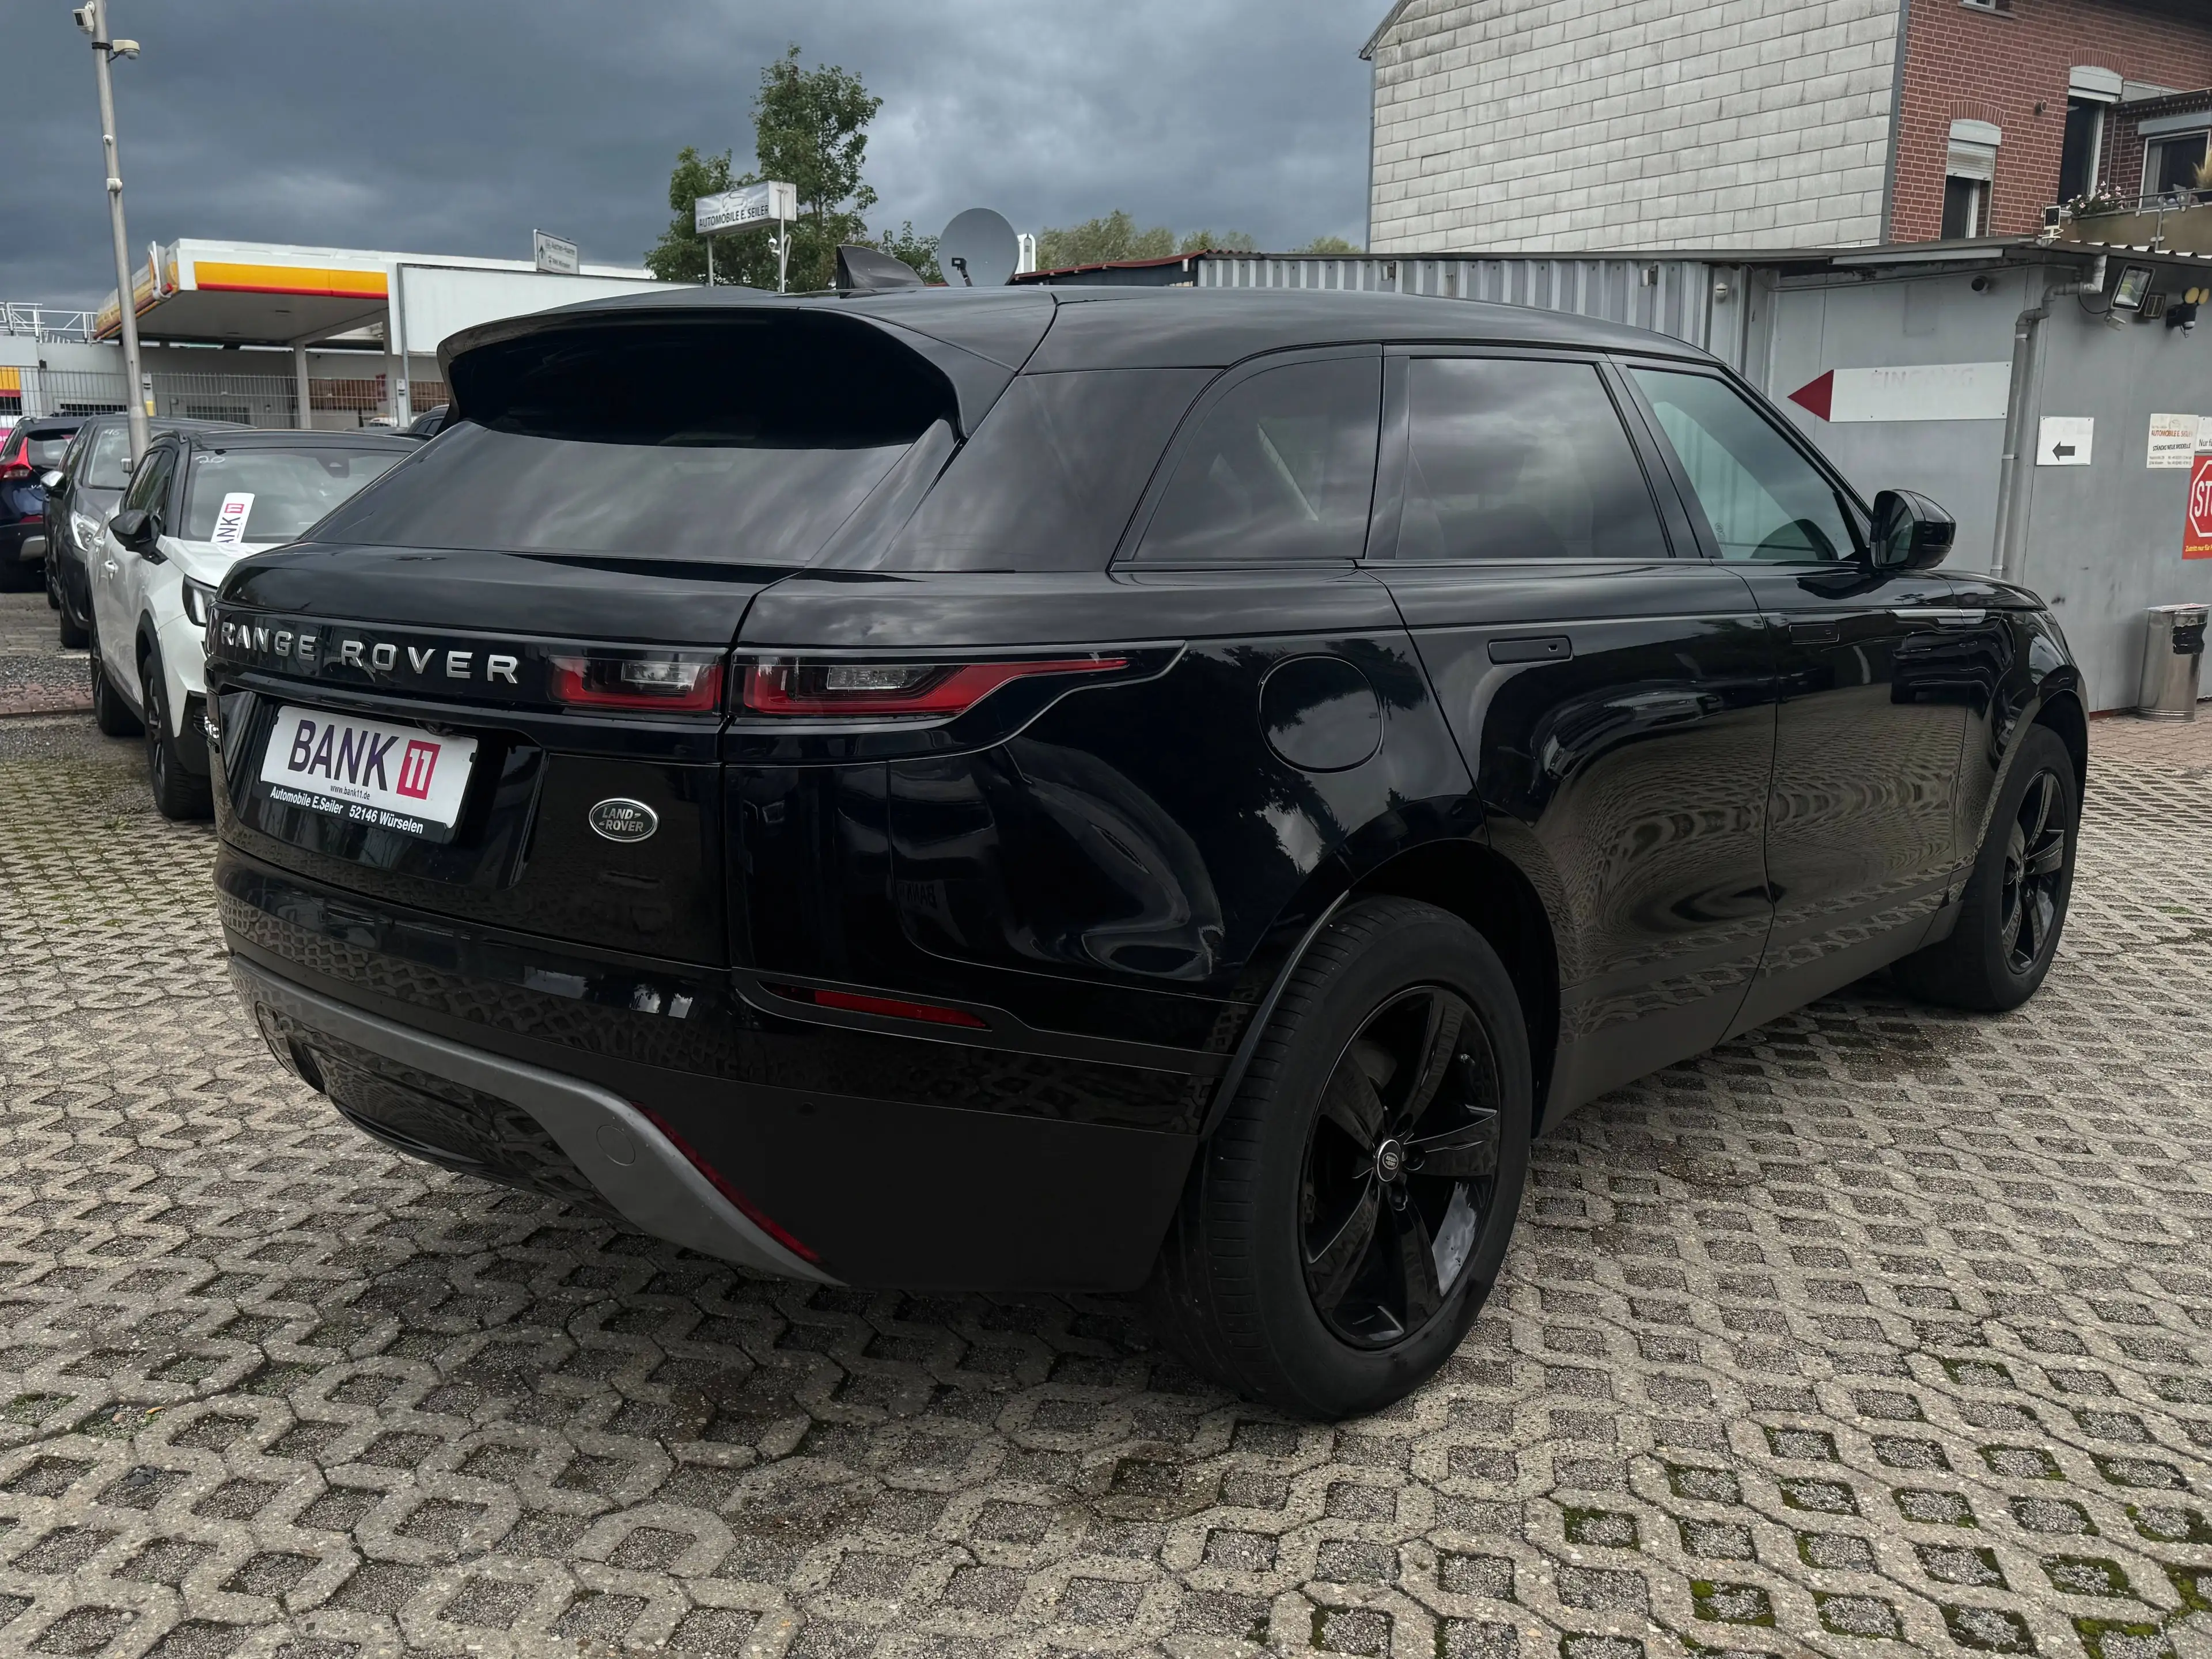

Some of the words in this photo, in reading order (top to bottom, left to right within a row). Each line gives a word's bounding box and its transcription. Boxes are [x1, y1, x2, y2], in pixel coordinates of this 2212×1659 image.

[699, 211, 739, 228] AUTOMOBILE
[741, 210, 746, 220] E.
[748, 204, 768, 218] SEILER
[195, 456, 225, 464] 20
[2194, 480, 2212, 517] ST
[221, 621, 317, 661] RANGE
[341, 639, 518, 684] ROVER
[287, 719, 400, 791] BANK
[404, 745, 435, 793] 11
[330, 784, 370, 800] www.bank11.de
[270, 785, 311, 807] Automobile
[312, 796, 344, 815] E.Seiler
[349, 805, 378, 823] 52146
[379, 811, 424, 834] Würselen
[605, 819, 644, 832] ROVER
